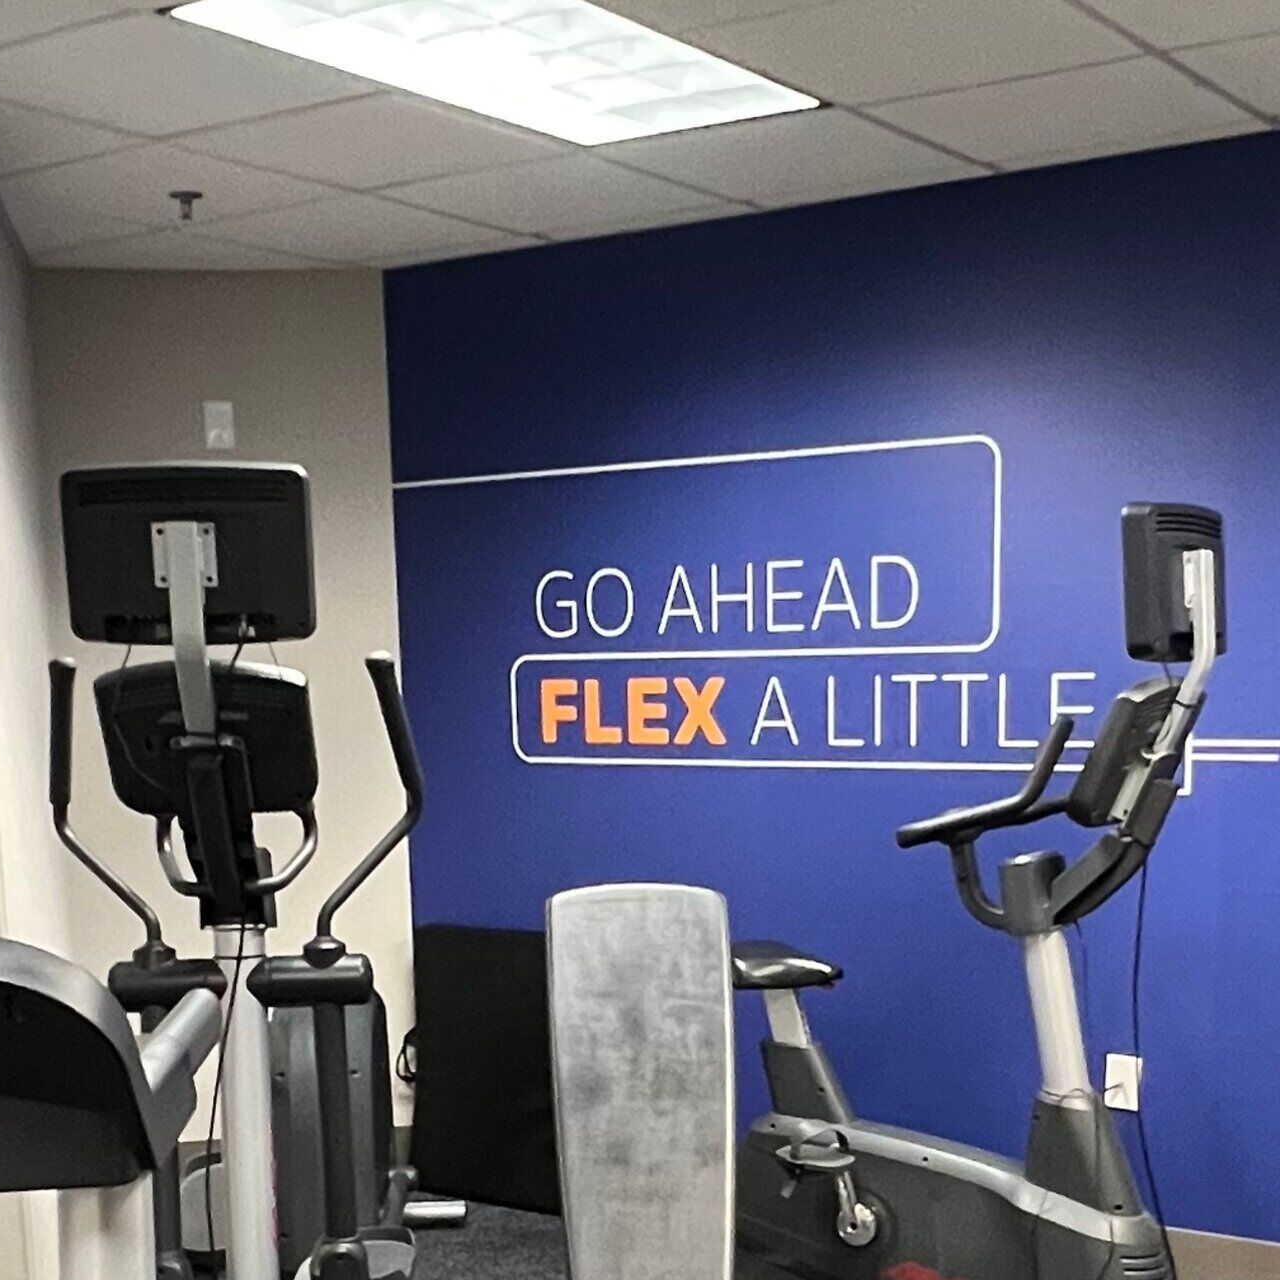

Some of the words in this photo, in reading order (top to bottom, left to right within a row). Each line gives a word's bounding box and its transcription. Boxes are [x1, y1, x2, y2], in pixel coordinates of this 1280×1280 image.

[534, 567, 635, 640] GO
[656, 553, 921, 636] AHEAD
[539, 676, 728, 745] FLEX
[749, 675, 800, 747] A
[826, 670, 1098, 750] LITTLE
